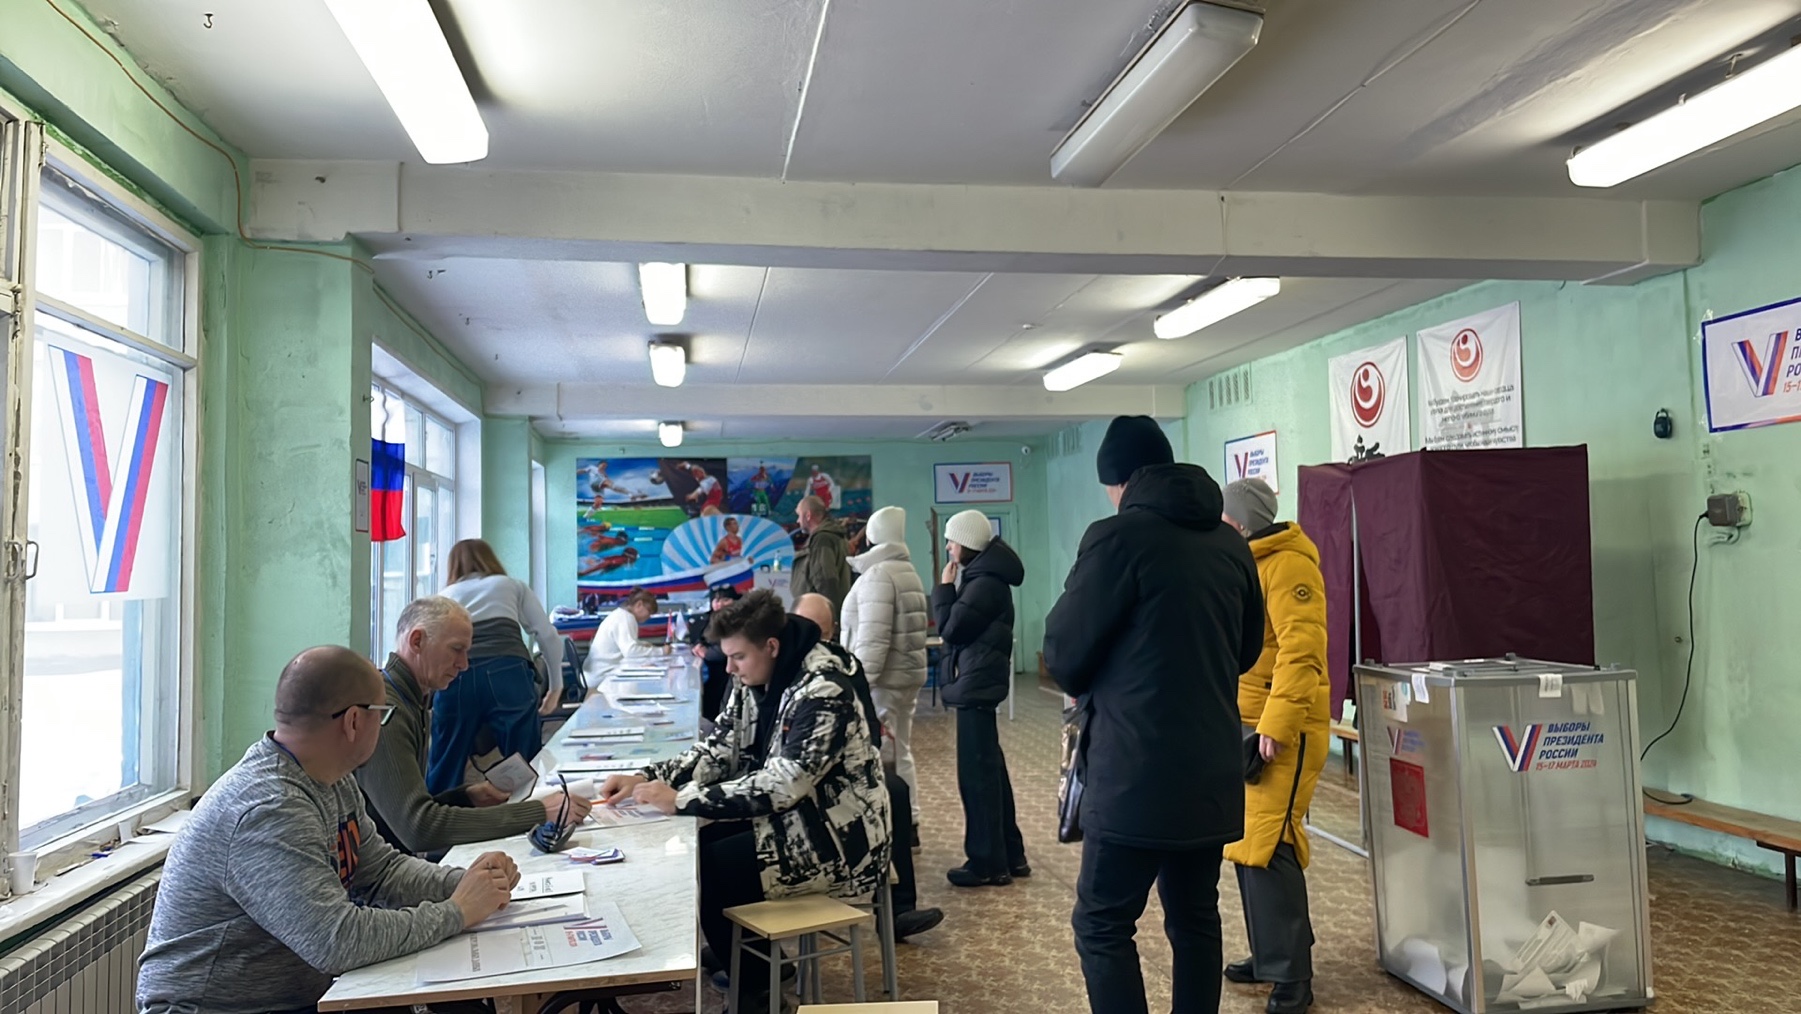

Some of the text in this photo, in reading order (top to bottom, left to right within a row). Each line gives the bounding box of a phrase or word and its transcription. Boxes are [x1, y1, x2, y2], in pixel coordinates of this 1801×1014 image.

[1547, 721, 1591, 733] ВЫБОРЫ
[1543, 733, 1604, 746] ПРЕЗИДЕНТА
[1539, 748, 1579, 759] РОССИИ
